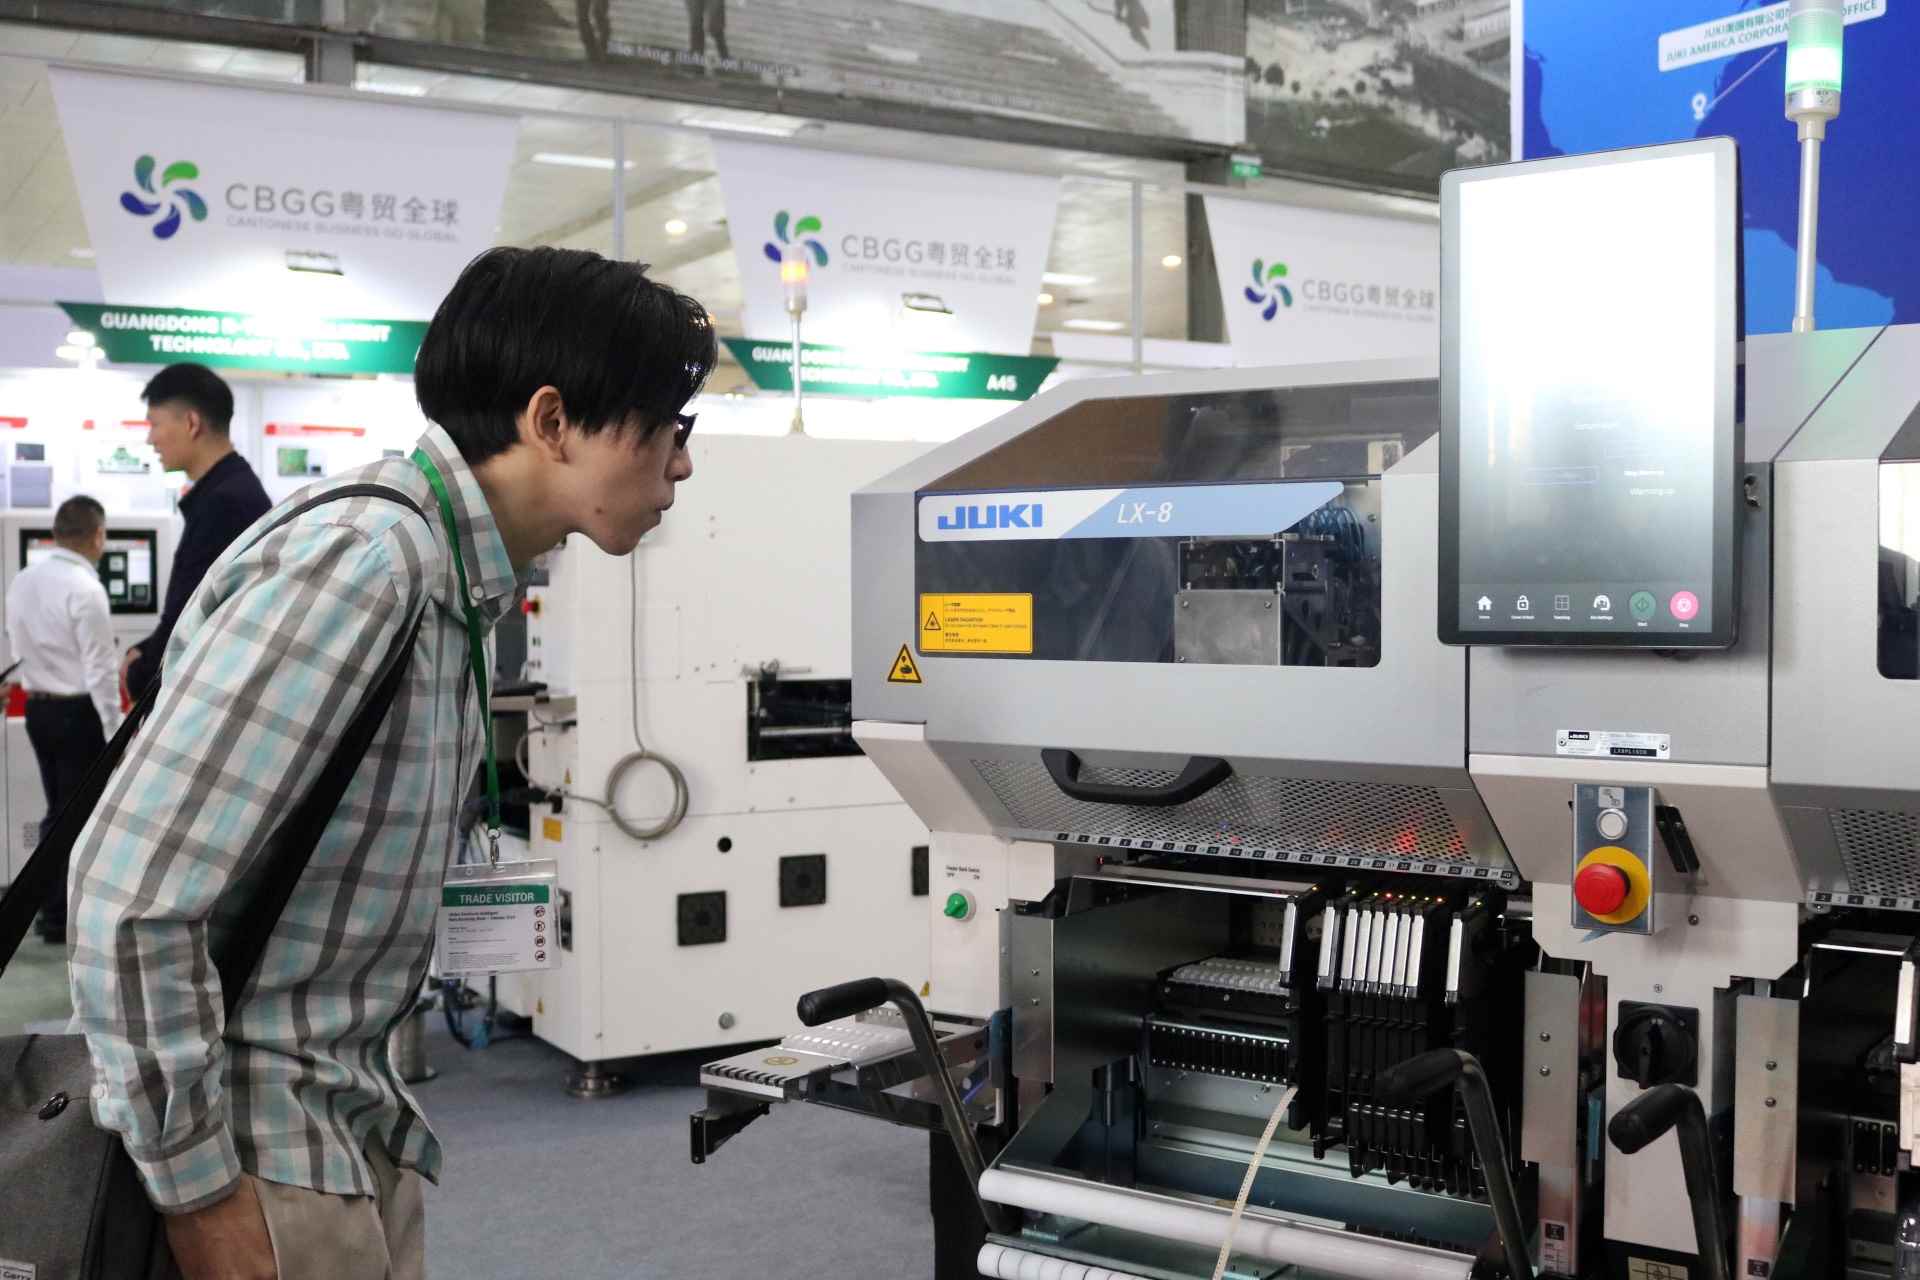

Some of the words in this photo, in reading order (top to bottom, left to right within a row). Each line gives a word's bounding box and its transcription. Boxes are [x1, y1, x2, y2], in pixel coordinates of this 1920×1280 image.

[1689, 36, 1737, 56] AMERICA
[1738, 21, 1790, 45] CORPORA
[986, 374, 1018, 392] A45
[937, 503, 1043, 530] JUKI
[1117, 501, 1174, 525] LX-8
[460, 894, 493, 905] TRADE
[495, 892, 535, 904] VISITOR
